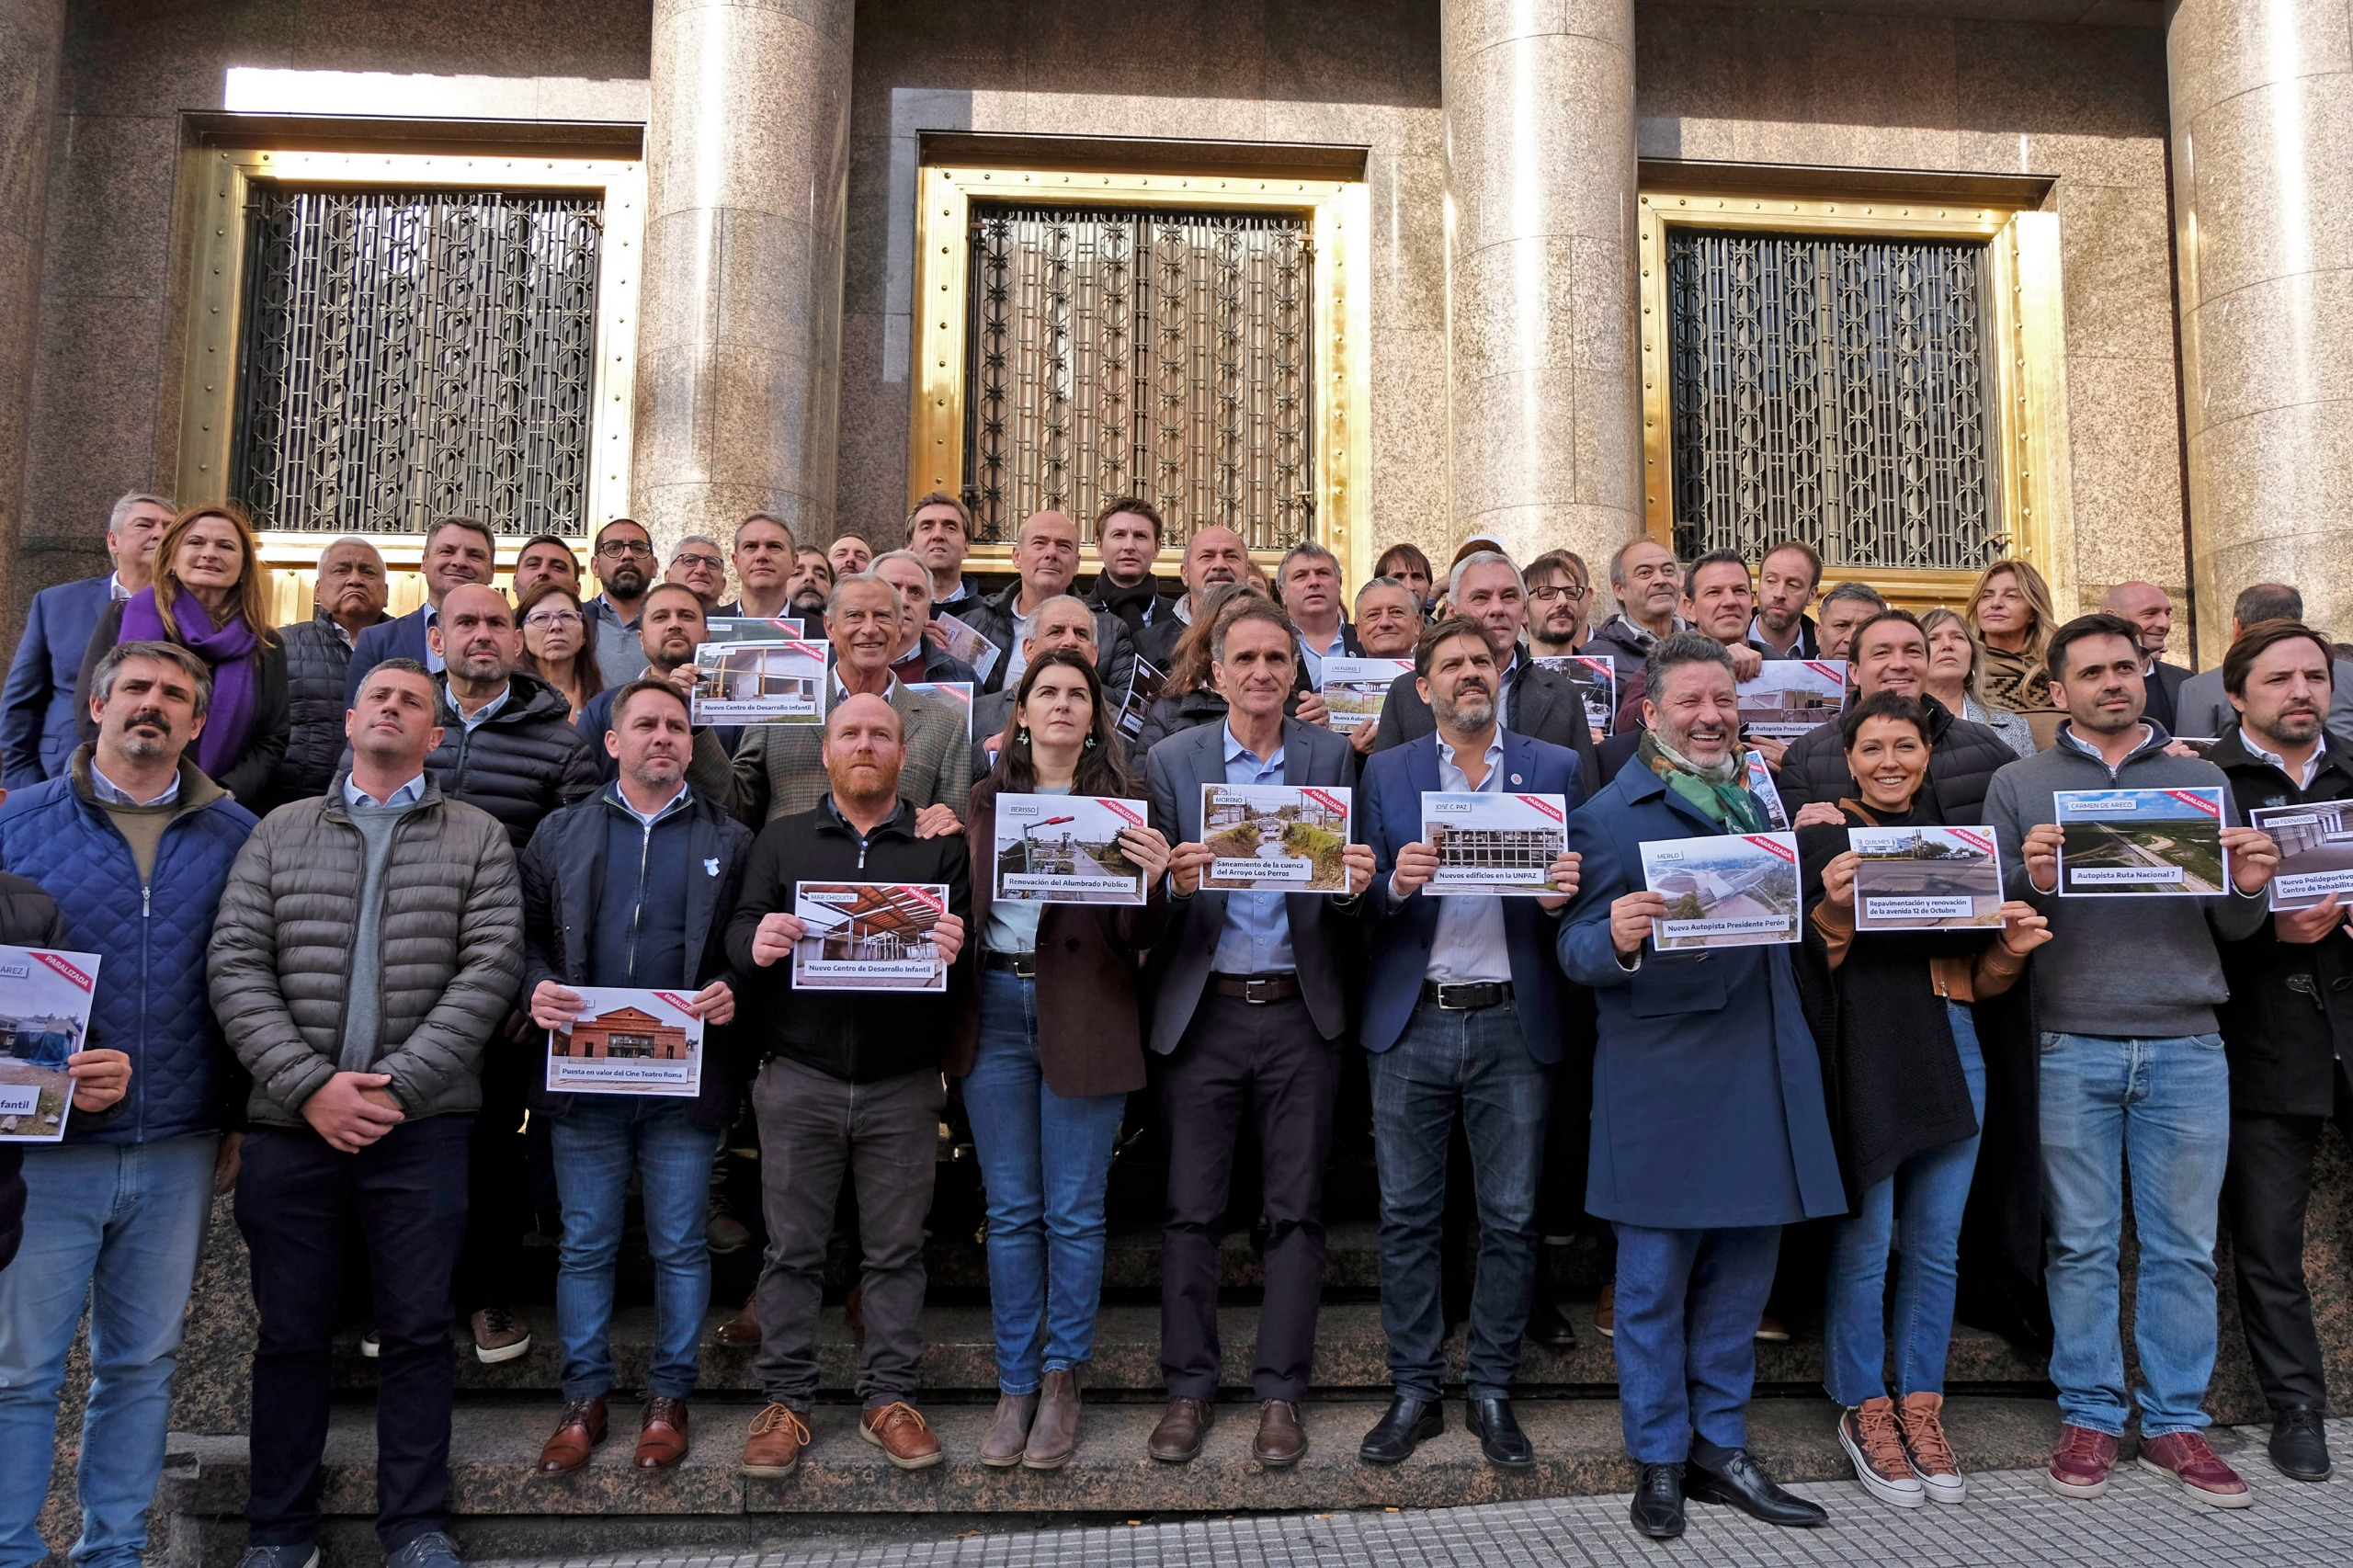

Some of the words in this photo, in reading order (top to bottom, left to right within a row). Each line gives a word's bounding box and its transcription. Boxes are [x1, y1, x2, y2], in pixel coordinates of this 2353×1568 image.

[773, 620, 799, 636] PARALIZADA
[792, 642, 823, 659] PARALIZADA
[1584, 658, 1609, 676] PARALIZADA
[1812, 663, 1840, 682] PARALIZADA
[941, 685, 968, 700] PARALIZADA
[1311, 790, 1345, 813] PARALIZADA
[1436, 802, 1449, 811] JOSÉ
[1527, 796, 1560, 818] PARALIZADA
[2176, 791, 2216, 814] PARALIZADA
[1108, 801, 1141, 825] PARALIZADA
[2280, 816, 2314, 824] FERNANDO
[1755, 837, 1791, 858] PARALIZADA
[1956, 829, 1991, 851] PARALIZADA
[1657, 852, 1679, 860] MERLO
[1009, 878, 1049, 886] Renovación
[2305, 874, 2353, 884] Polideportivo
[907, 887, 941, 911] PARALIZADA
[1870, 900, 1925, 908] Repavimentación
[1690, 923, 1725, 932] Autopista
[1727, 921, 1764, 929] Presidente
[45, 954, 89, 987] PARALIZADA
